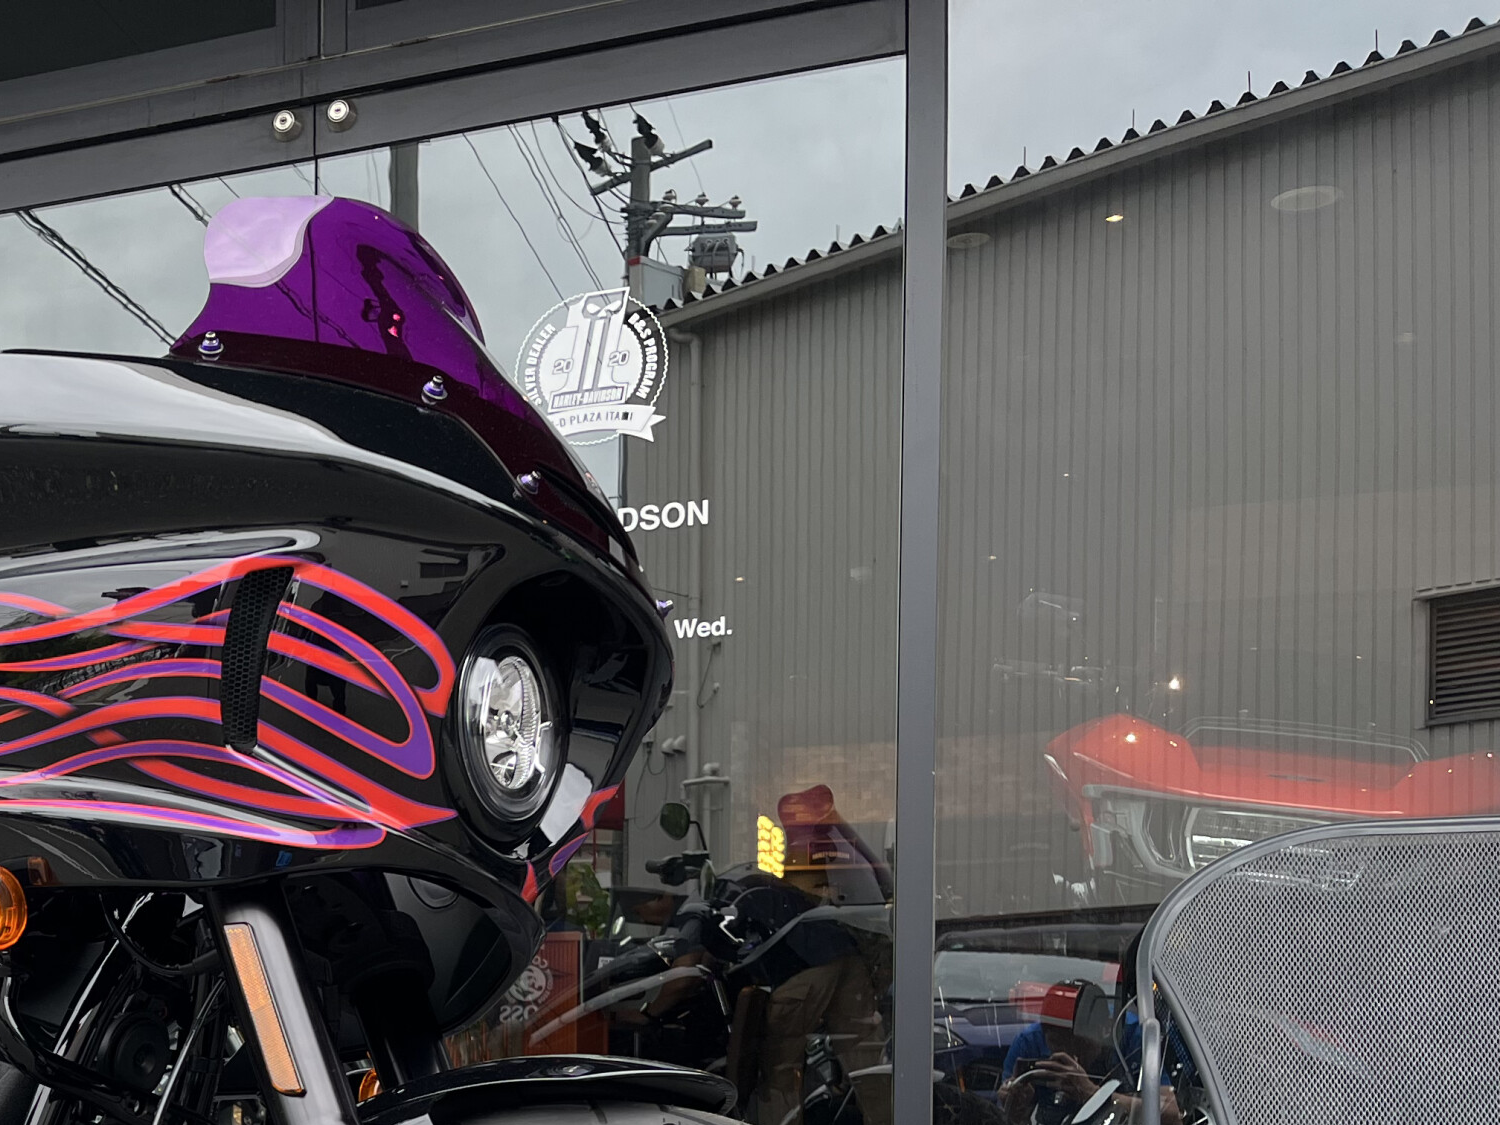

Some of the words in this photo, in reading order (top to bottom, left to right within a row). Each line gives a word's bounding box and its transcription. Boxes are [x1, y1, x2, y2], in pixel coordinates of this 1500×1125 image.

[526, 323, 556, 365] DEALER
[636, 337, 658, 399] PROGRAM
[553, 387, 623, 408] HARLEY-DAVIDSON
[570, 412, 602, 426] PLAZA
[618, 499, 709, 533] DSON
[674, 616, 733, 638] Wed.
